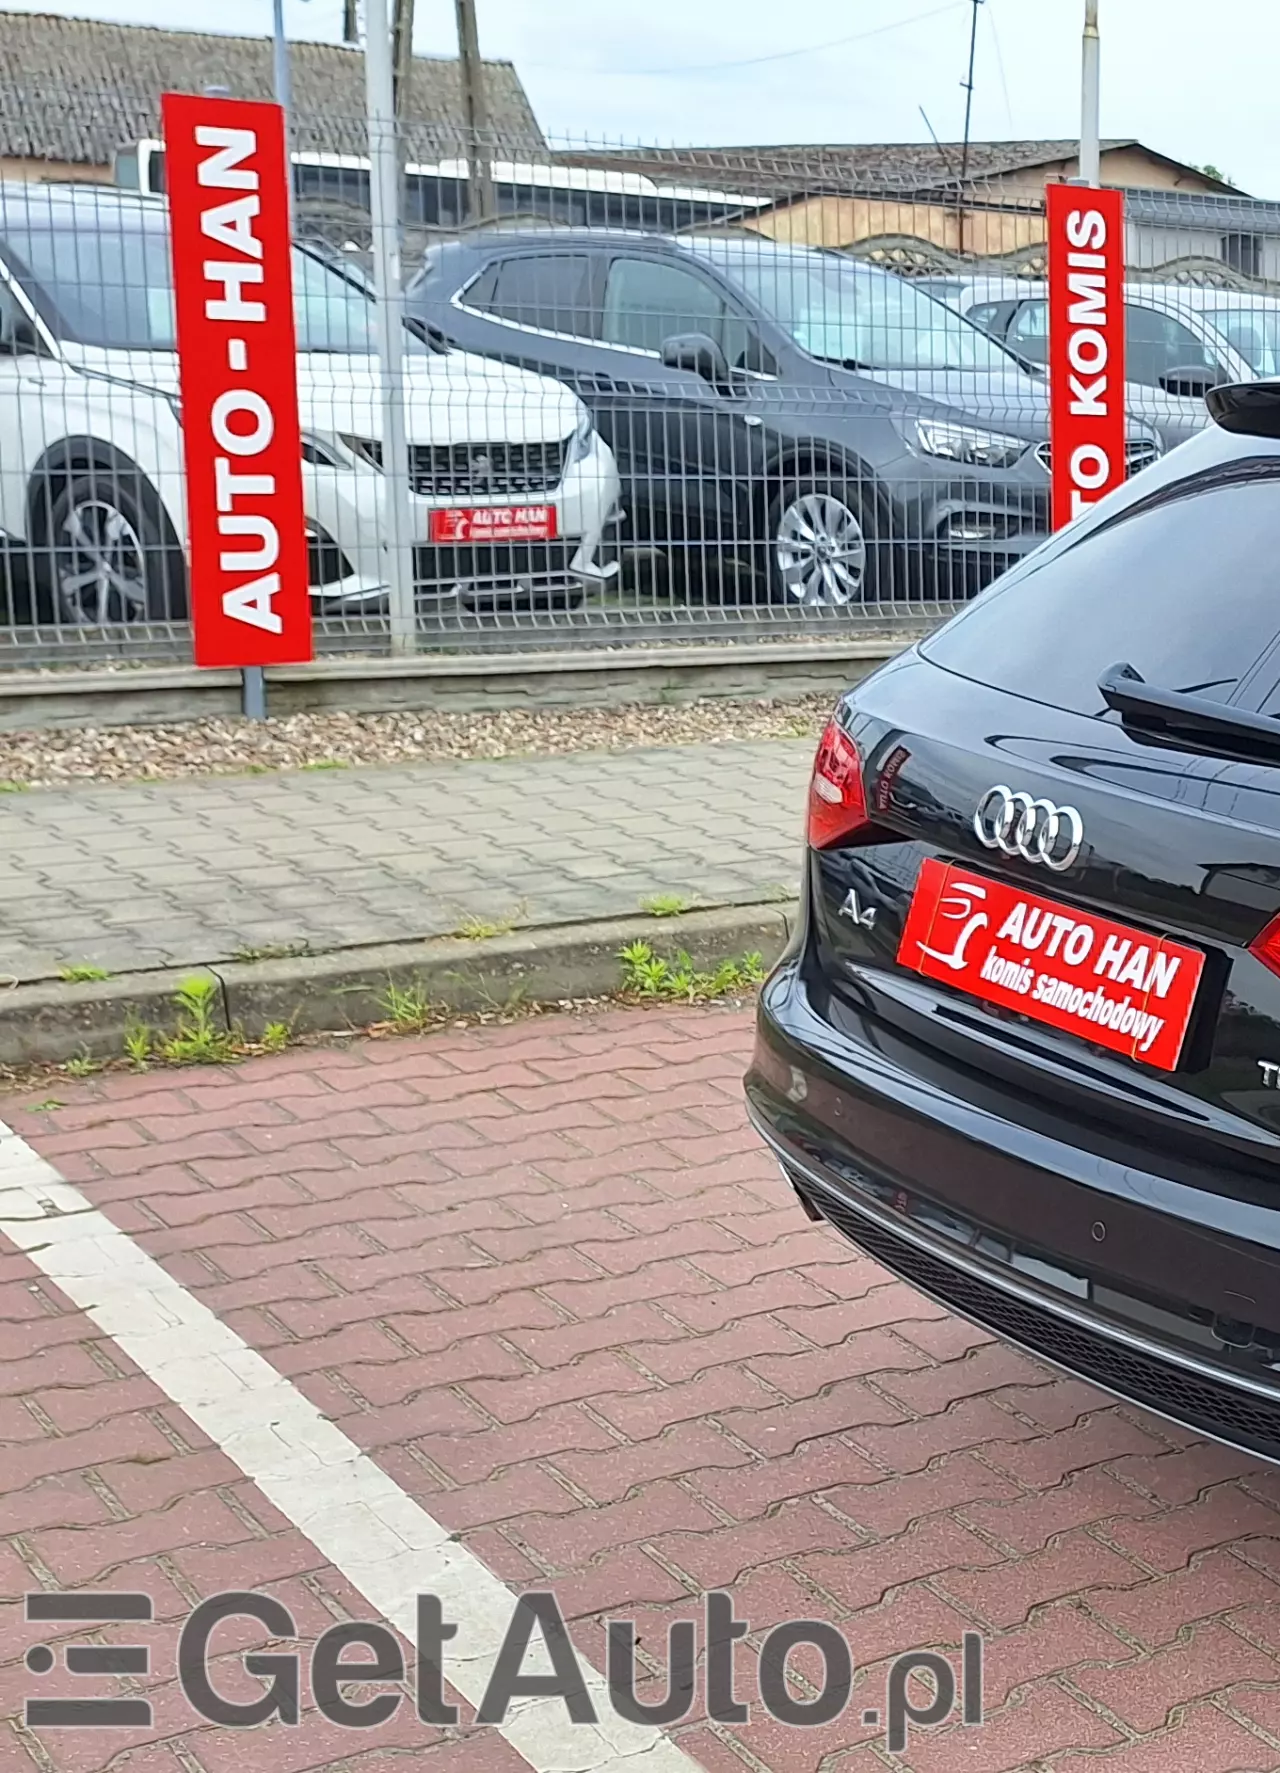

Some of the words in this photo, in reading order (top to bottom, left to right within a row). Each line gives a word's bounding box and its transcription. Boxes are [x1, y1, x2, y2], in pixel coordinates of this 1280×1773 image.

[194, 125, 267, 322] HAN
[1066, 209, 1108, 416] KOMIS
[211, 389, 283, 634] AUTO
[838, 888, 877, 931] A4
[996, 901, 1094, 966] AUTO
[1093, 934, 1182, 999] HAN
[980, 945, 1035, 995] komis
[1031, 970, 1165, 1052] samochodowy
